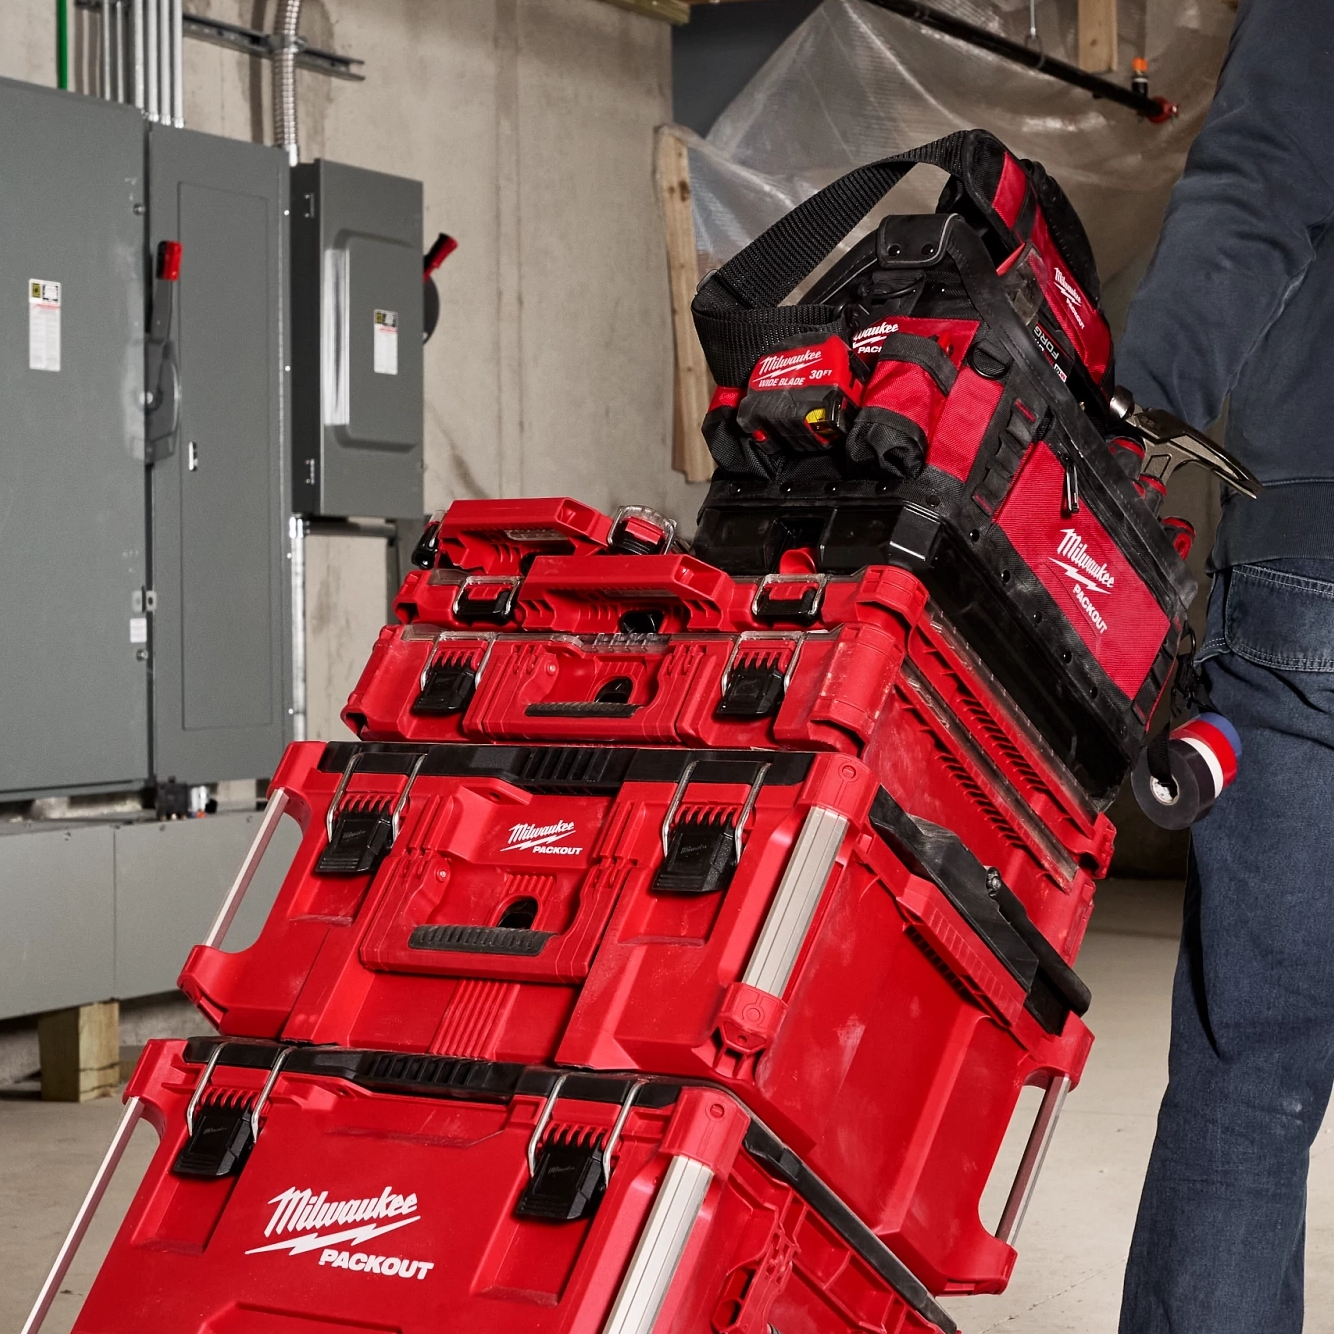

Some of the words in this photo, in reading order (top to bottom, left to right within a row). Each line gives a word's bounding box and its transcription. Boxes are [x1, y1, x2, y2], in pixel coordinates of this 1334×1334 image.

[853, 321, 899, 341] waukee
[1033, 325, 1060, 360] FORG
[759, 349, 822, 376] Milwaukee
[758, 378, 778, 387] WIDE
[778, 377, 806, 386] BLADE
[1056, 528, 1115, 588] Milwaukee
[1073, 583, 1108, 634] PACKOUT
[507, 820, 576, 844] Milwaukee
[532, 845, 583, 856] PACKOUT
[264, 1186, 418, 1238] Milwaukee
[318, 1249, 434, 1280] PACKOUT
